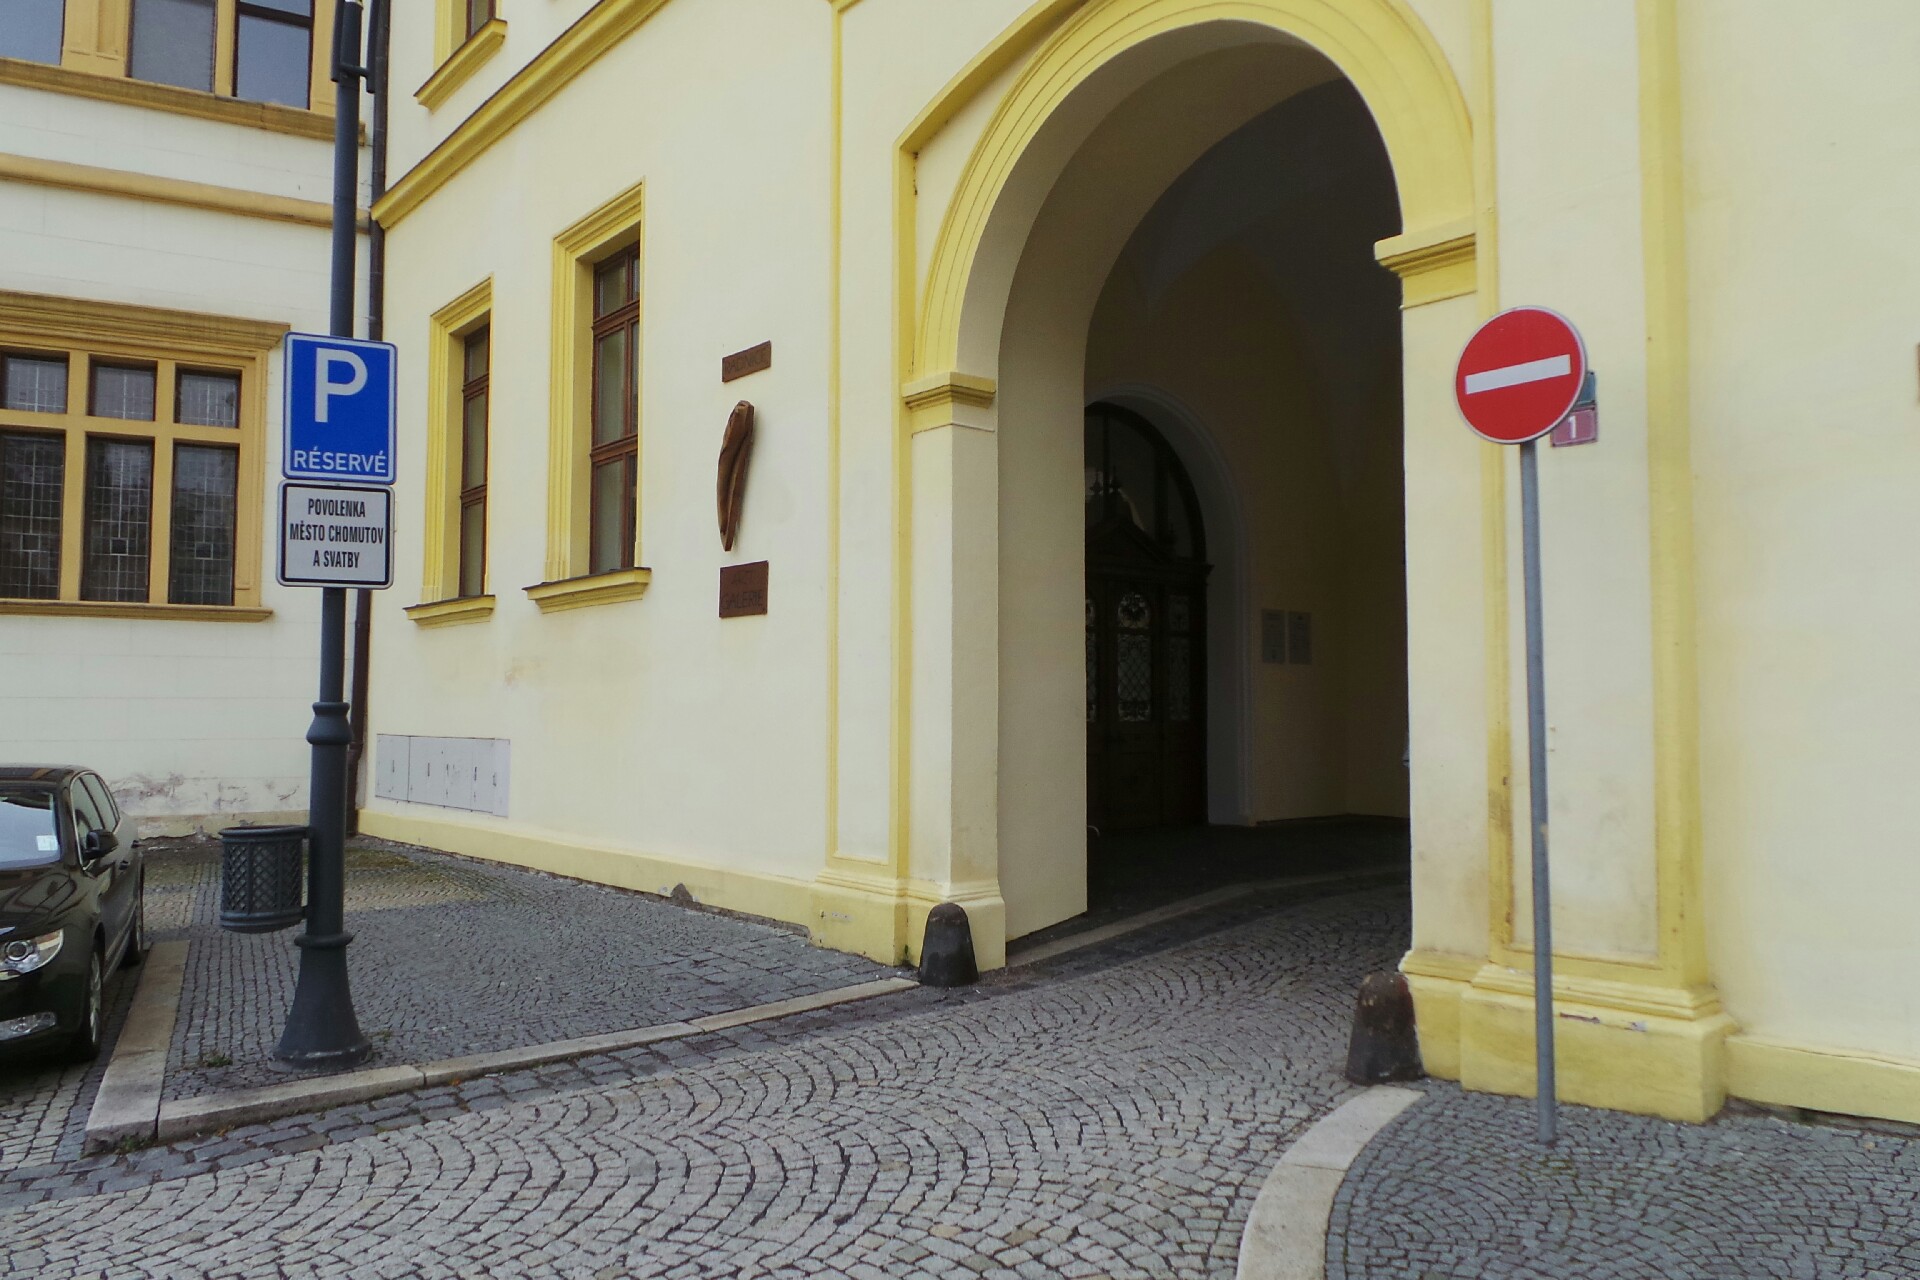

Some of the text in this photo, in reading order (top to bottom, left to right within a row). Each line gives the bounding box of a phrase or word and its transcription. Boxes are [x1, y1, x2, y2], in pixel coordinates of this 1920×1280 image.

[315, 347, 368, 423] P
[1568, 415, 1577, 439] 1
[293, 445, 387, 473] RÉSERVÉ
[308, 498, 366, 518] POVOLENKA
[289, 520, 384, 544] MĚSTO CHOMUTOV
[313, 549, 360, 569] A SVATBY
[721, 589, 763, 609] GALERIE
